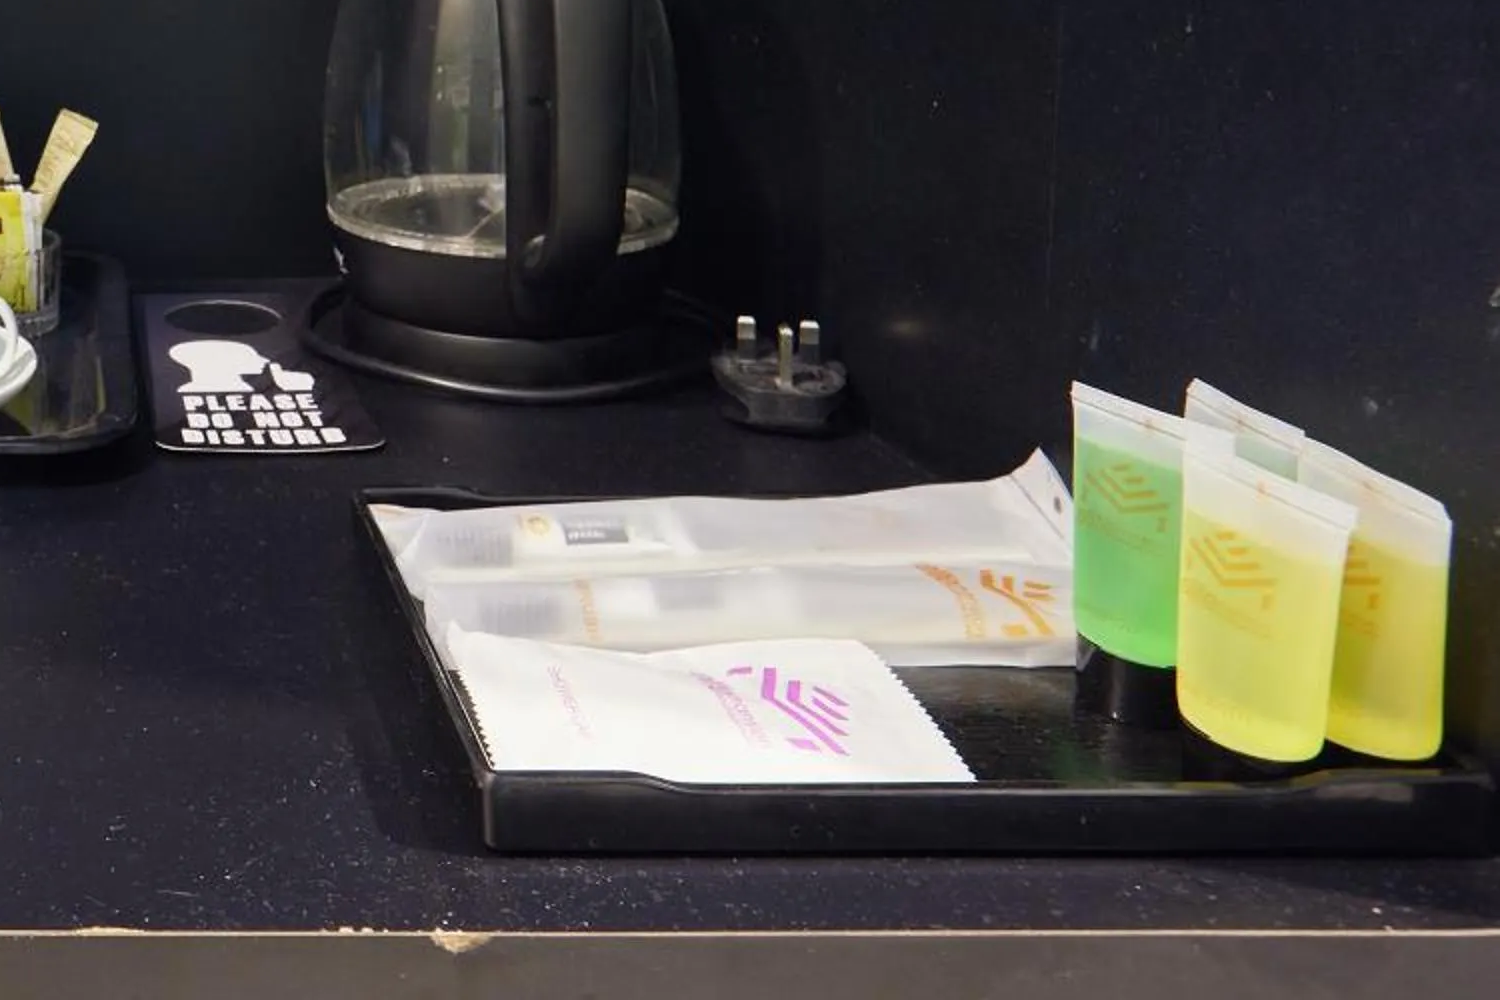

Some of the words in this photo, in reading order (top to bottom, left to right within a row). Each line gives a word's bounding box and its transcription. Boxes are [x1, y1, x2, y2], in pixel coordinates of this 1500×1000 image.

[182, 393, 319, 412] PLEASE
[186, 411, 233, 429] DO
[252, 411, 324, 429] NOT
[180, 427, 347, 445] DISTURB
